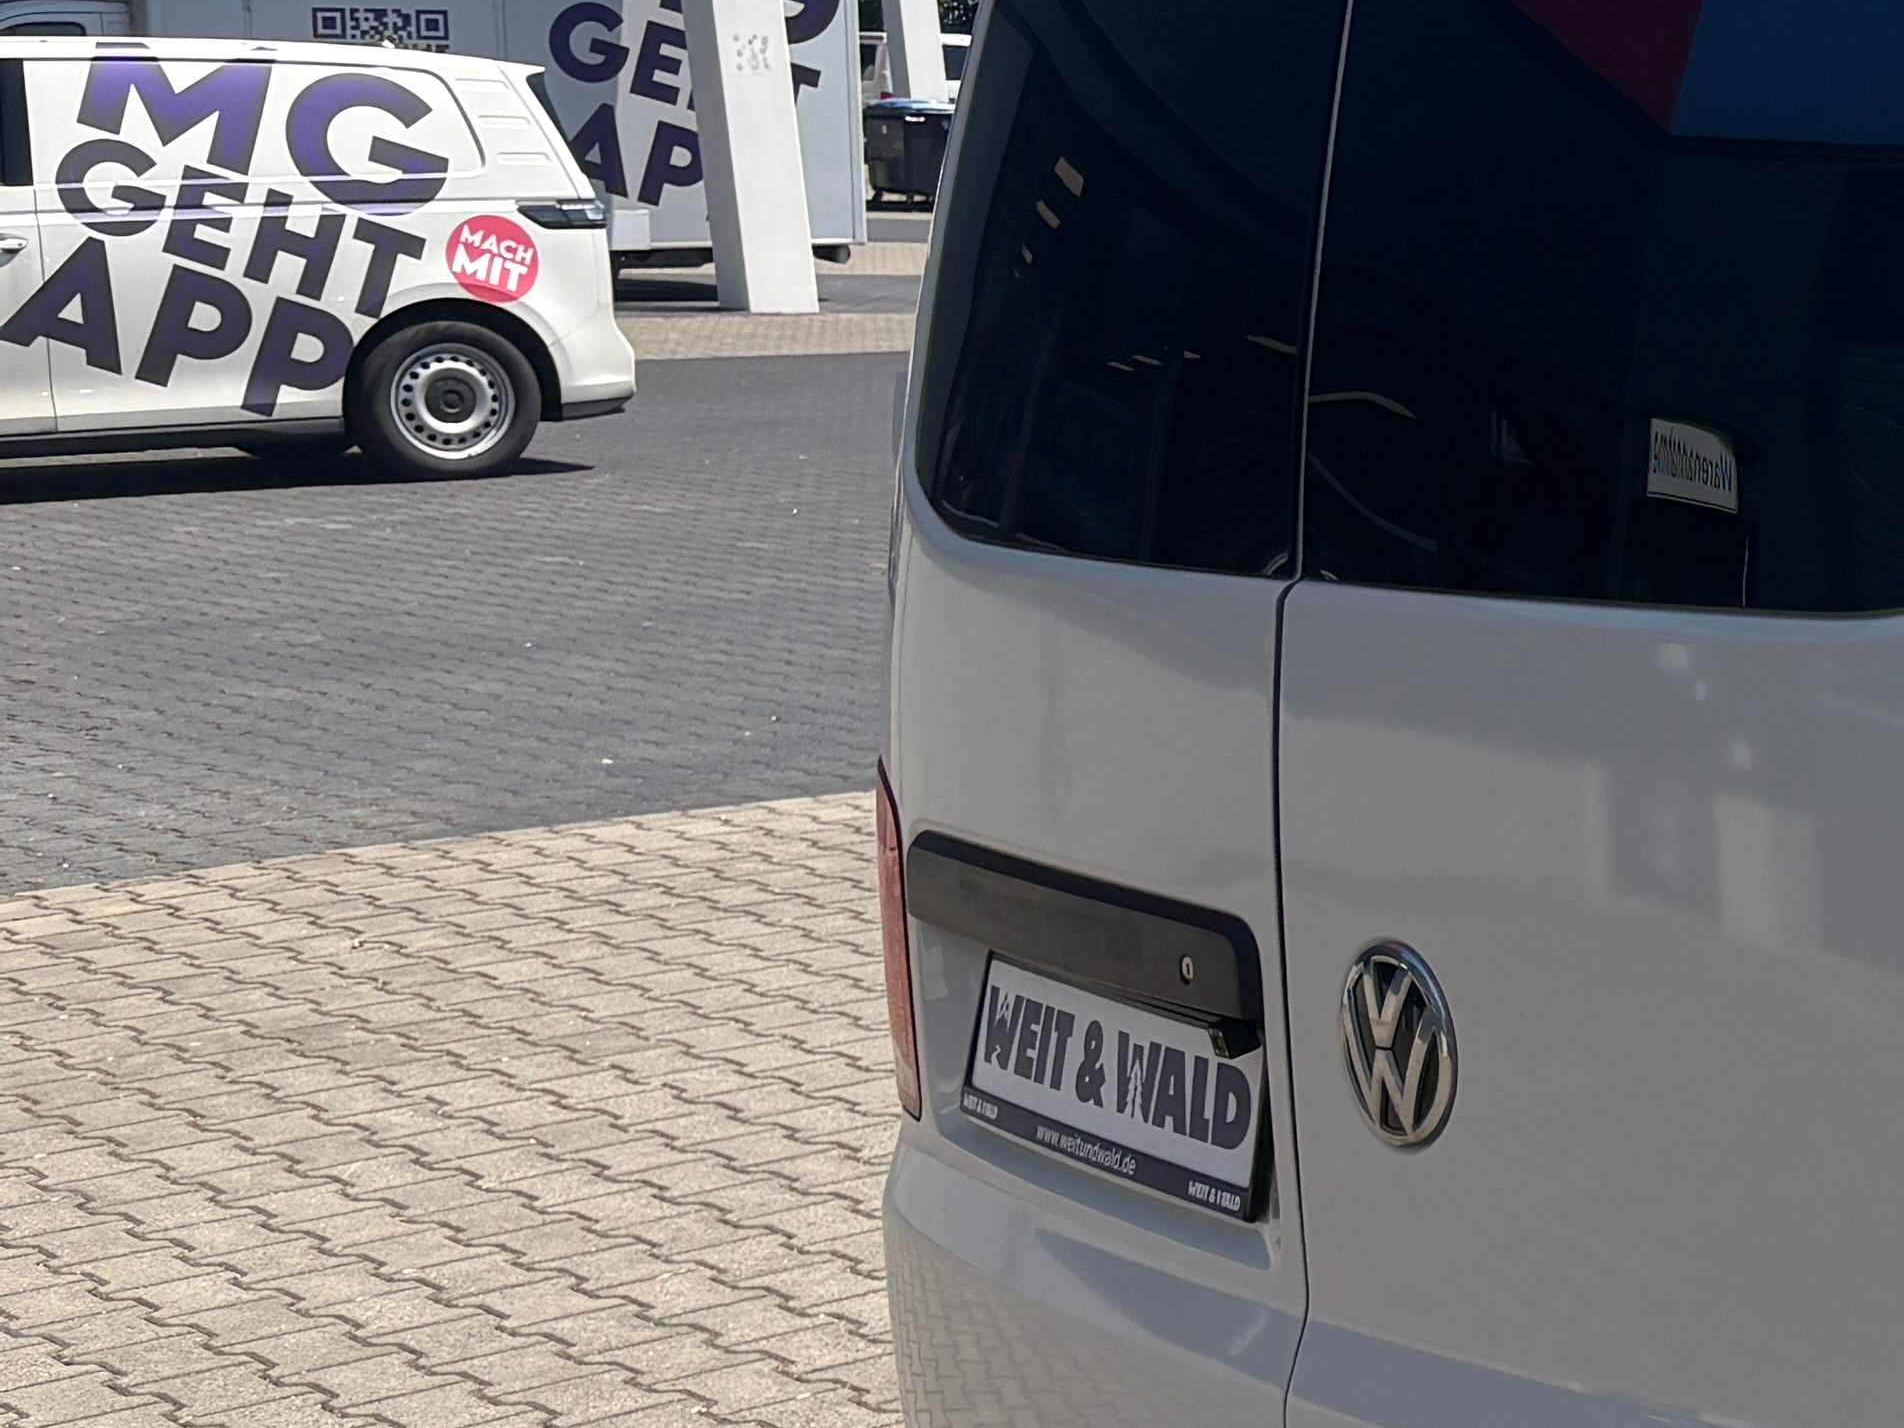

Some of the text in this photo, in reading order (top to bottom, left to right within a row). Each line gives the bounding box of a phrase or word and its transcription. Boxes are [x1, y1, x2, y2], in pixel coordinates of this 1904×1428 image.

[549, 2, 822, 110] GE
[77, 43, 449, 216] MG
[570, 103, 704, 206] AP
[55, 138, 427, 320] GEHT
[451, 243, 529, 292] MIT
[459, 224, 534, 265] MACH
[0, 236, 355, 418] APP
[984, 985, 1252, 1151] WEIT & WALD
[1036, 1124, 1137, 1176] www.weitundwald.de
